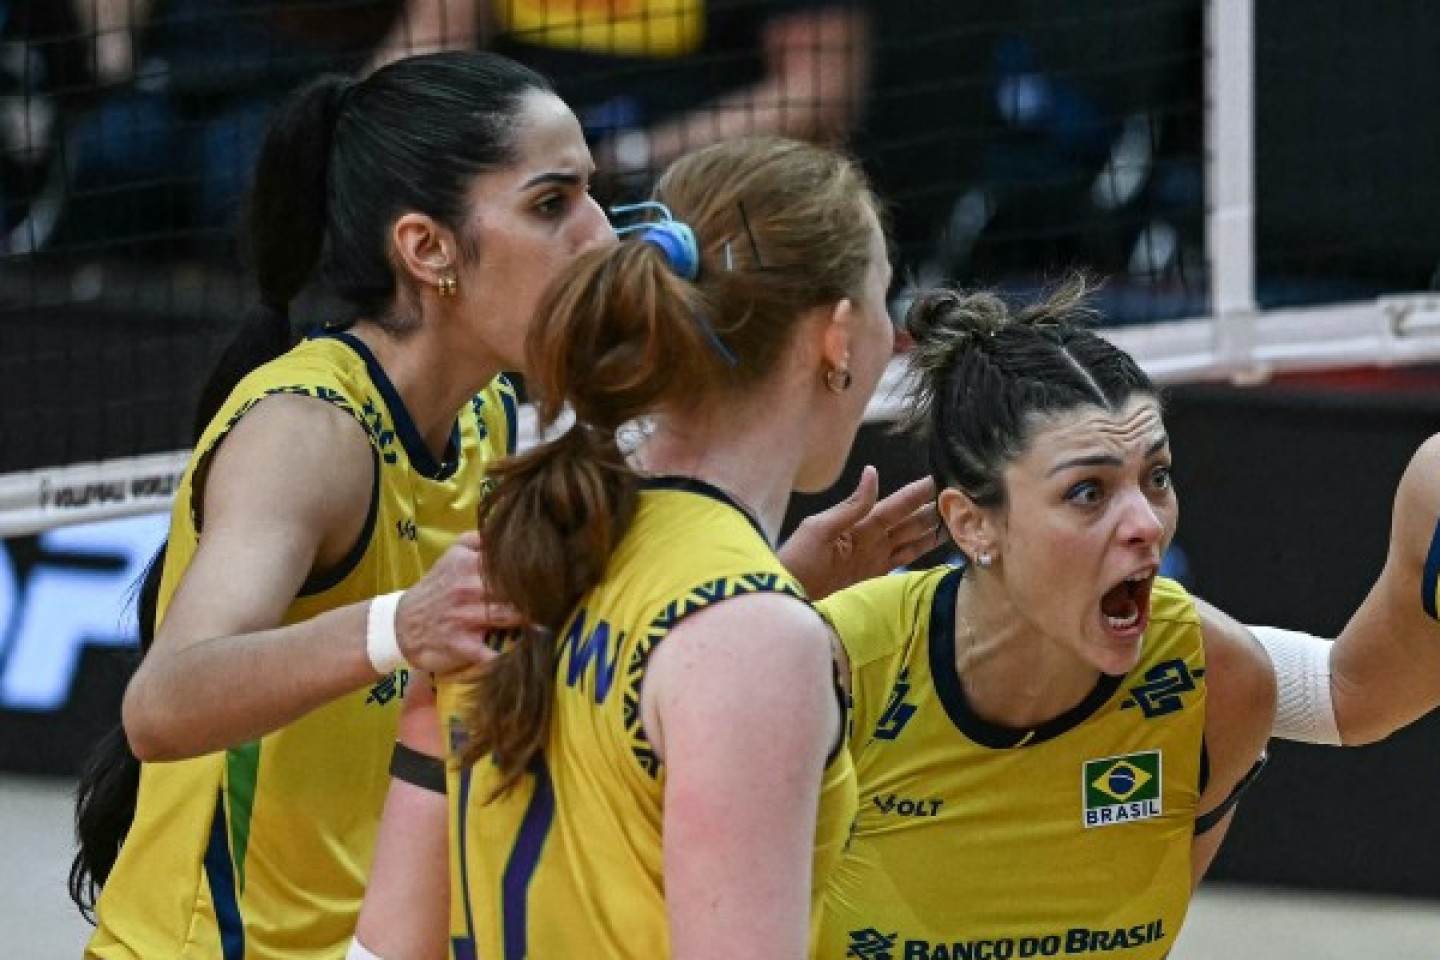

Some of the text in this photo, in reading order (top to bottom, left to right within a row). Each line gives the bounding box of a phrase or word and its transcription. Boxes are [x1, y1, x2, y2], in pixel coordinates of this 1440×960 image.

[873, 794, 944, 818] VOLT
[1086, 799, 1160, 824] BRASIL
[1018, 935, 1060, 957] DO
[1064, 918, 1166, 954] BRASIL
